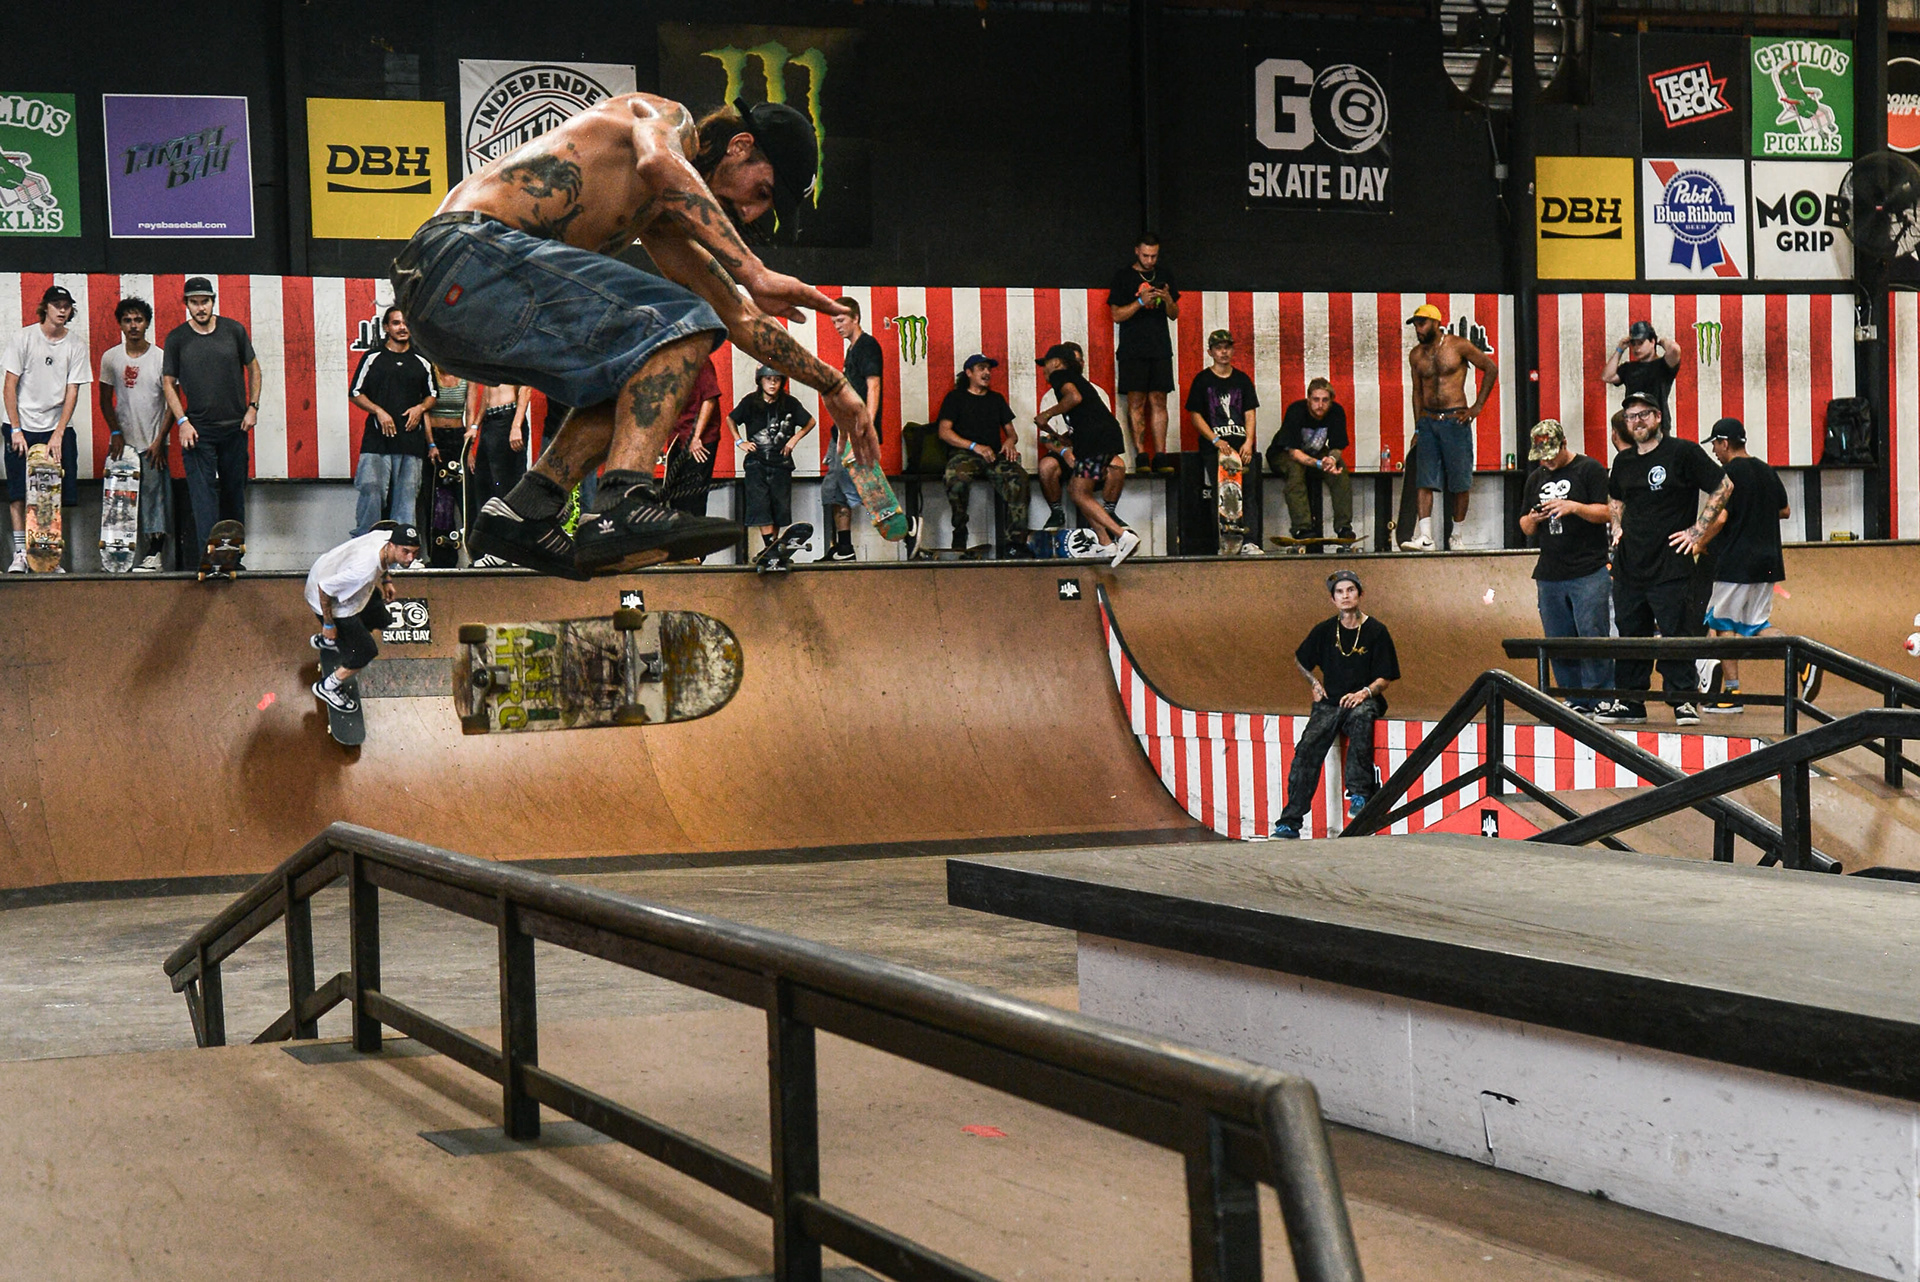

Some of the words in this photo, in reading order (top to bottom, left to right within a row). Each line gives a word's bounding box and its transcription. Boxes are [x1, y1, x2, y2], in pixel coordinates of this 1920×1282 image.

[1756, 43, 1848, 73] GRILLO'S
[1655, 67, 1710, 102] TECH
[476, 72, 602, 130] INDEPENDE
[1666, 86, 1723, 121] DECK
[1766, 135, 1841, 152] PICKLES
[326, 144, 431, 177] DBH
[1248, 162, 1332, 199] SKATE
[1340, 166, 1390, 201] DAY
[1673, 180, 1714, 204] Pabst
[1541, 197, 1622, 224] DBH
[1655, 205, 1686, 223] Blue
[1687, 205, 1733, 223] Ribbon
[1755, 189, 1850, 229] MOB
[138, 221, 227, 230] raysbaseball.com
[1776, 230, 1835, 252] GRIP
[382, 630, 412, 641] SKATE
[413, 630, 430, 641] DAY
